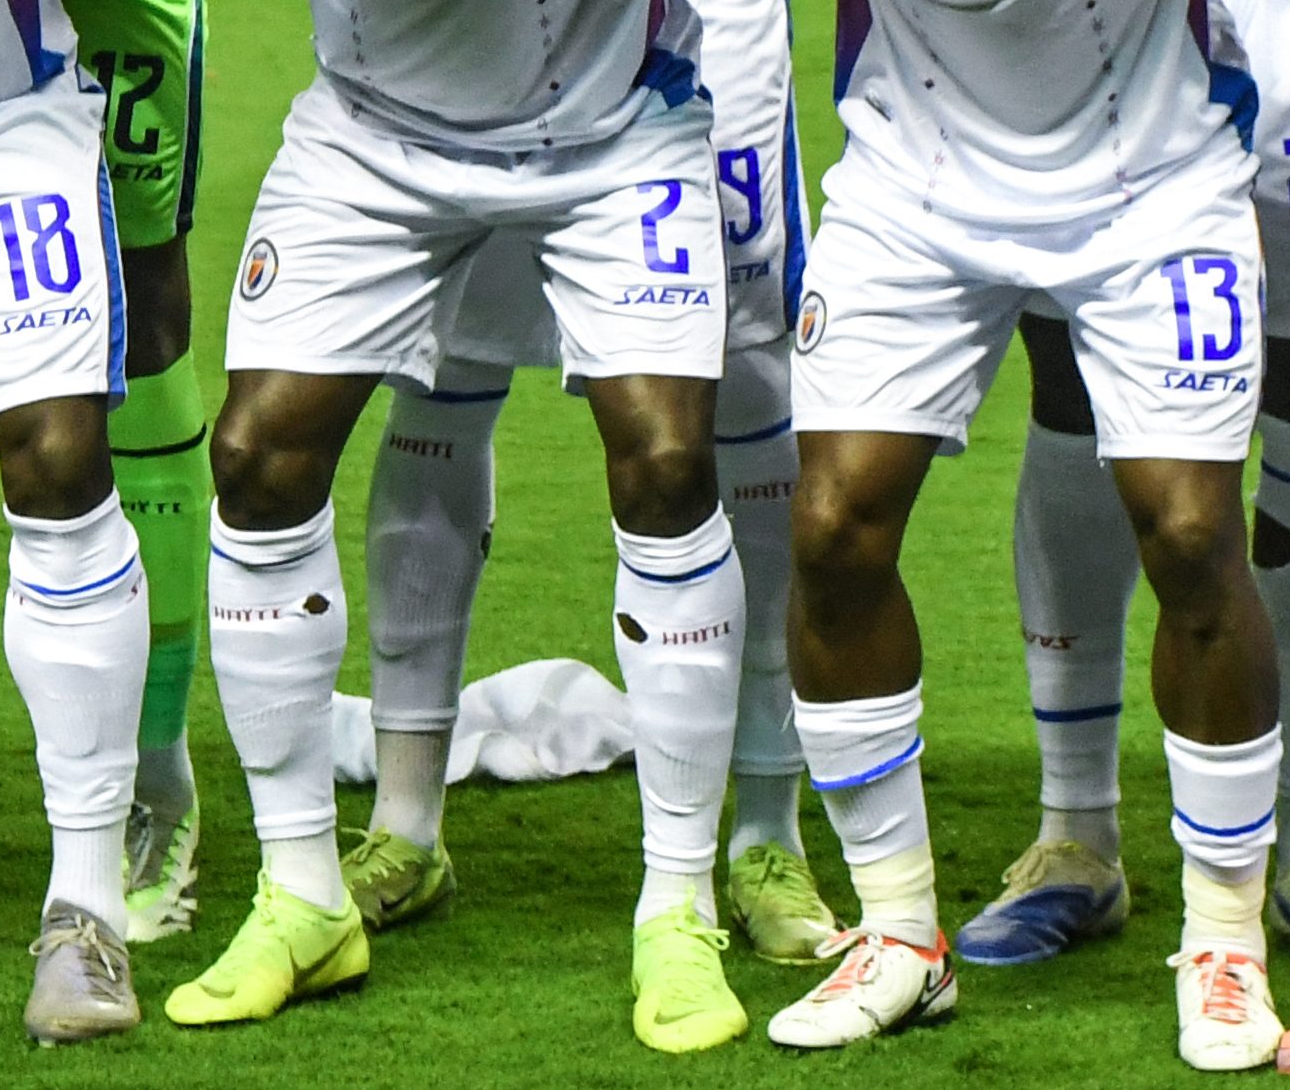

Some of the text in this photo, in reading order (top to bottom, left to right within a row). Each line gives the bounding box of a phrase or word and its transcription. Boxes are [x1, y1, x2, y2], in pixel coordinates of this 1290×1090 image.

[91, 50, 165, 155] 12
[111, 162, 163, 181] ETA
[636, 178, 690, 275] 2
[730, 260, 770, 284] ETA
[613, 286, 710, 307] SAETA
[1160, 256, 1242, 361] 13
[1155, 371, 1249, 394] SAETA
